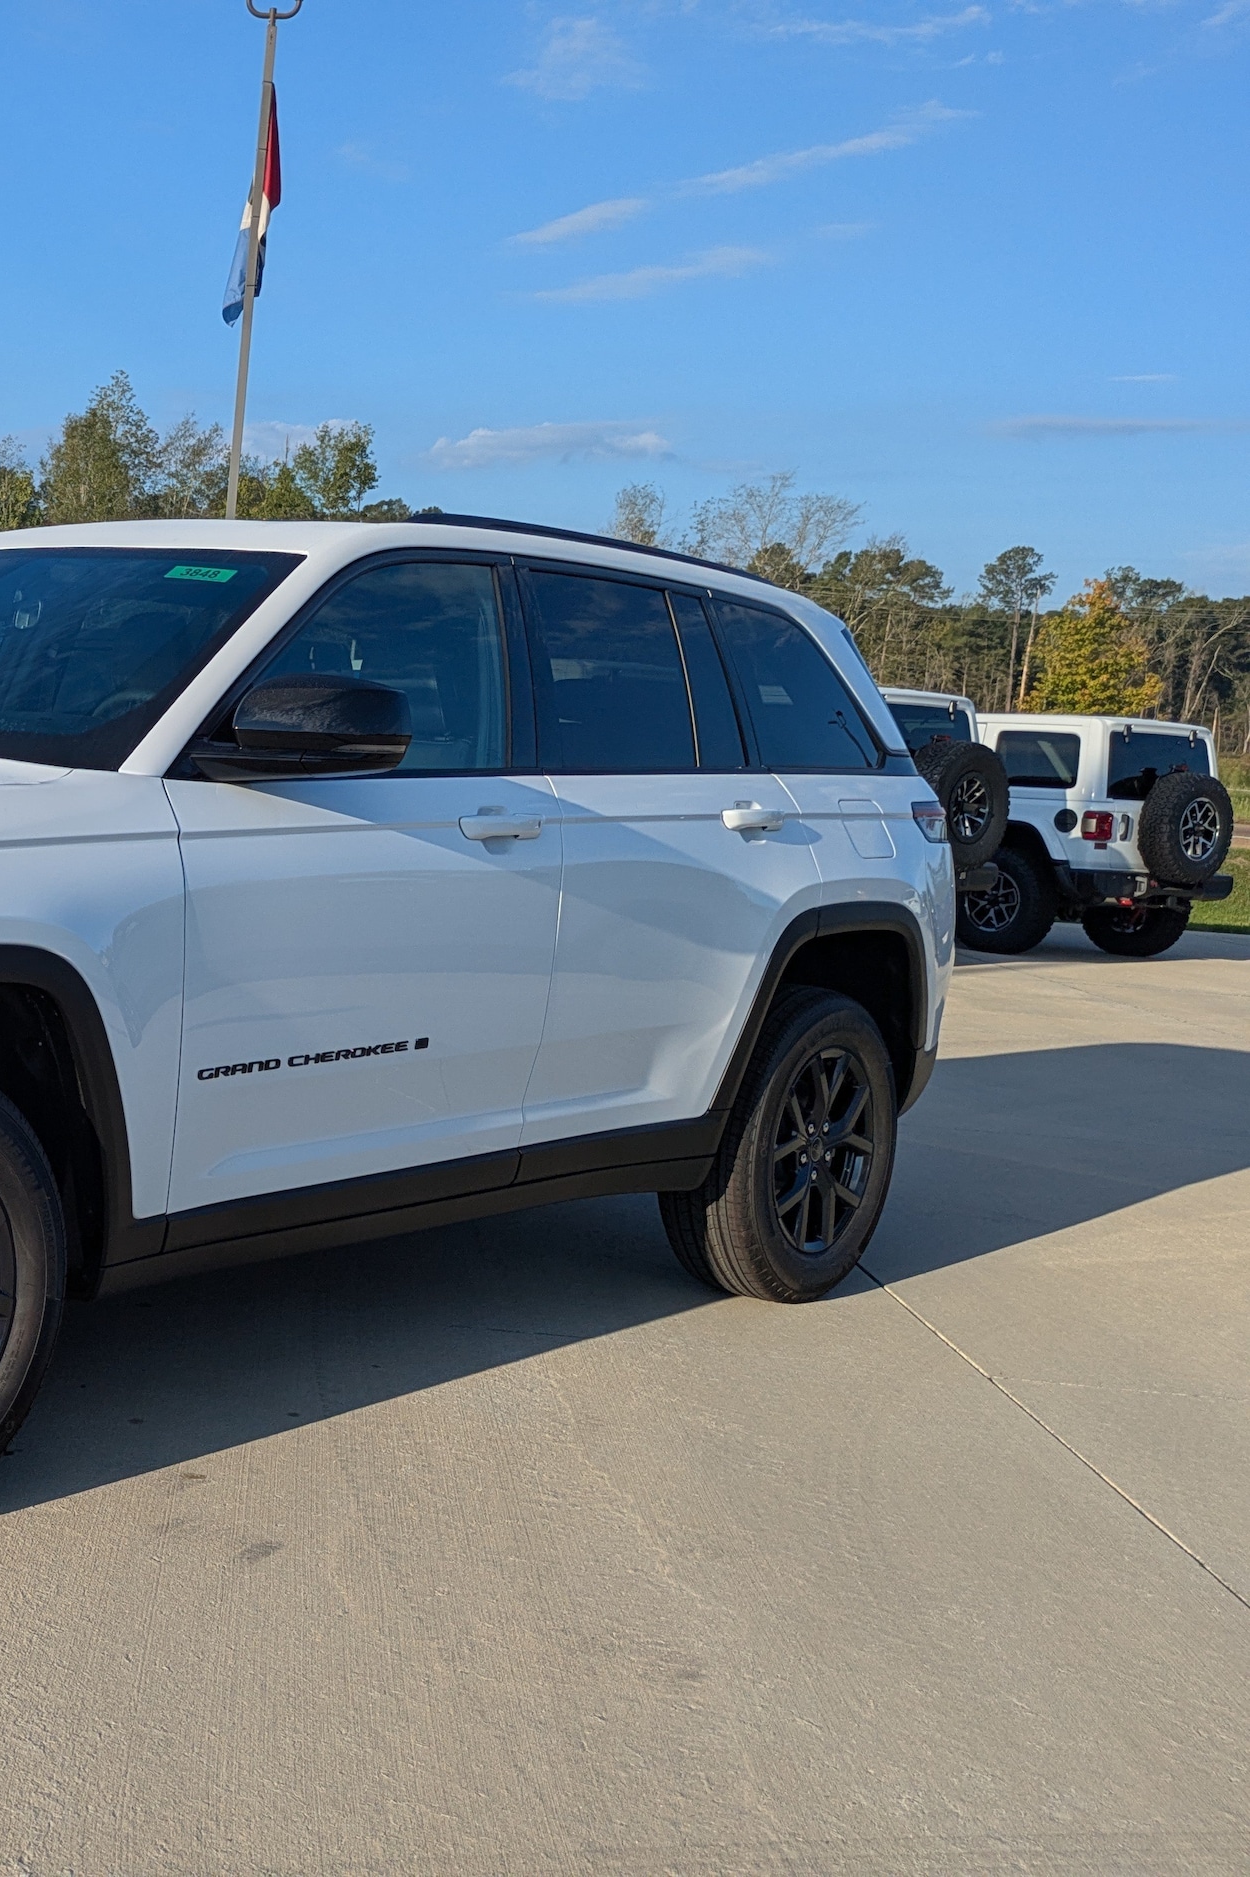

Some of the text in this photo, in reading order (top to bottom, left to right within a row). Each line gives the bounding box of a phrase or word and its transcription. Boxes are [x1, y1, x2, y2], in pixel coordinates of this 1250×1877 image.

[180, 568, 220, 579] 3848
[197, 1040, 409, 1081] GRAND CHEROKEE
